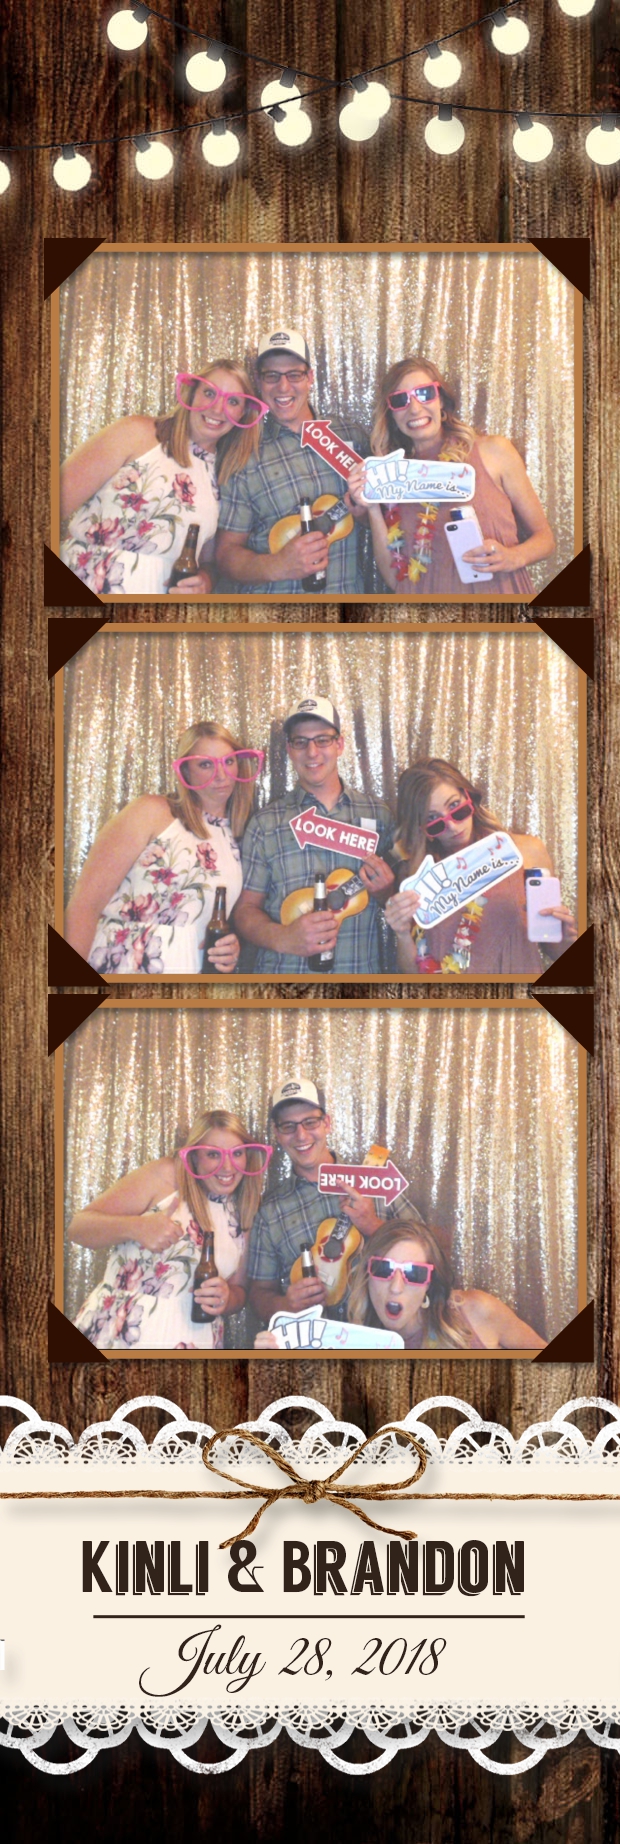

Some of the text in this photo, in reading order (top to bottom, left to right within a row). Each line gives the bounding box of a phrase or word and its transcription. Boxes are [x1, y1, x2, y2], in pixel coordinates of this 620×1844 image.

[305, 423, 358, 472] LOOK HE
[366, 460, 409, 489] HI!
[376, 484, 404, 500] My
[405, 479, 444, 492] Name
[295, 818, 376, 852] LOOK HERE
[430, 891, 458, 915] My
[452, 863, 490, 893] Name
[359, 1175, 400, 1191] LOOK
[270, 1319, 328, 1349] HI!
